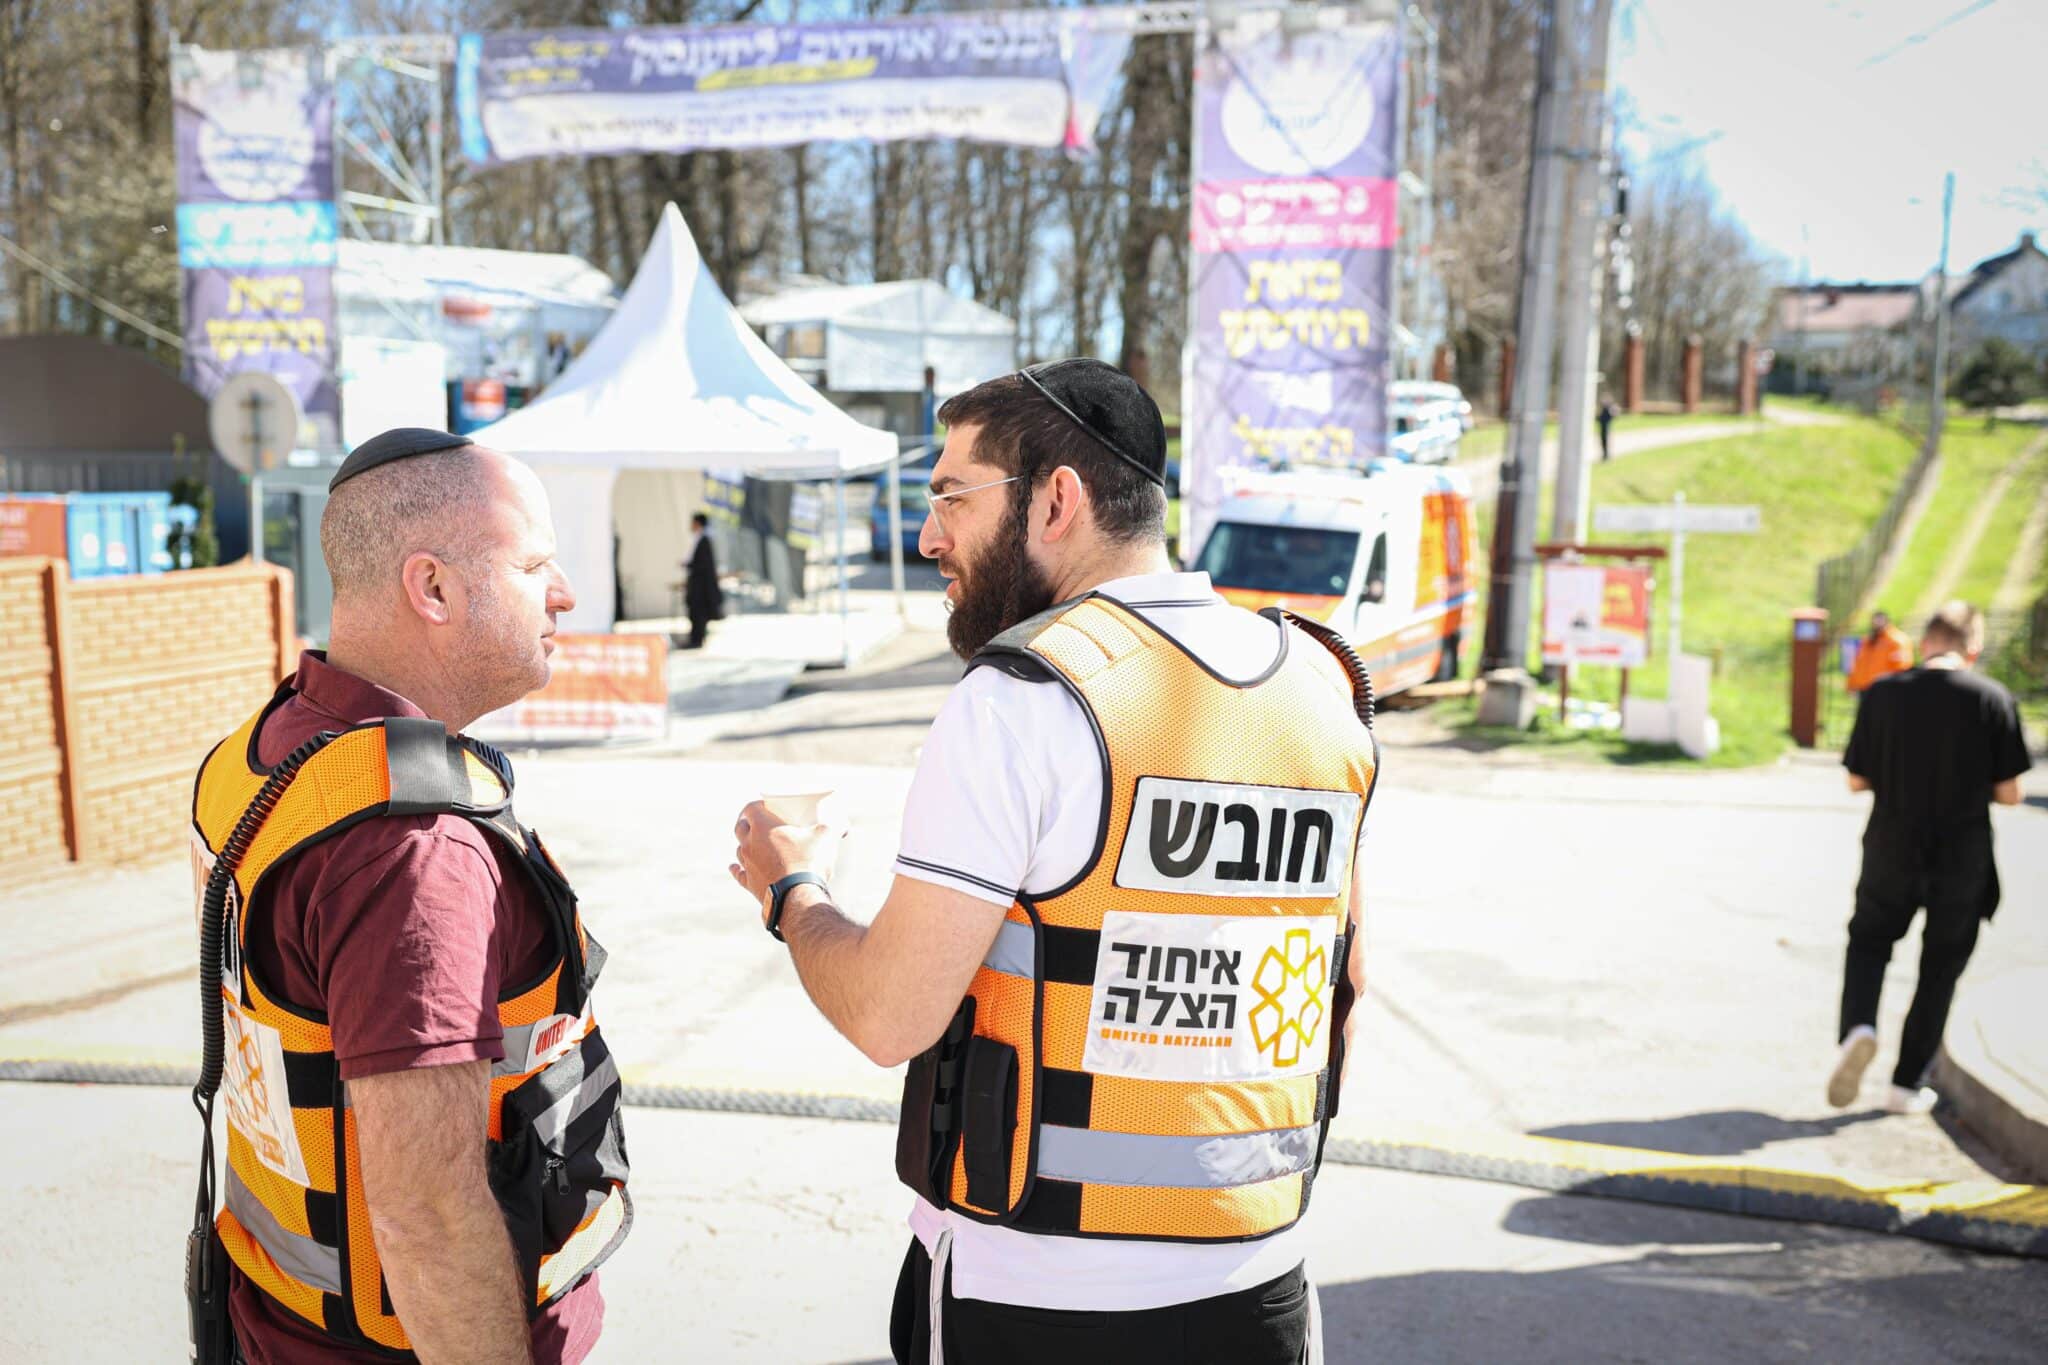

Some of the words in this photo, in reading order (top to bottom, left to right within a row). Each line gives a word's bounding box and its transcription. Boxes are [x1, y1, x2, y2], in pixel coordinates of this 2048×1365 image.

[1149, 799, 1333, 883] חובש
[1111, 941, 1242, 986] איחוד
[1103, 985, 1238, 1029] הצלה
[1101, 1028, 1159, 1045] UNITED
[1163, 1034, 1233, 1047] HATZALAH
